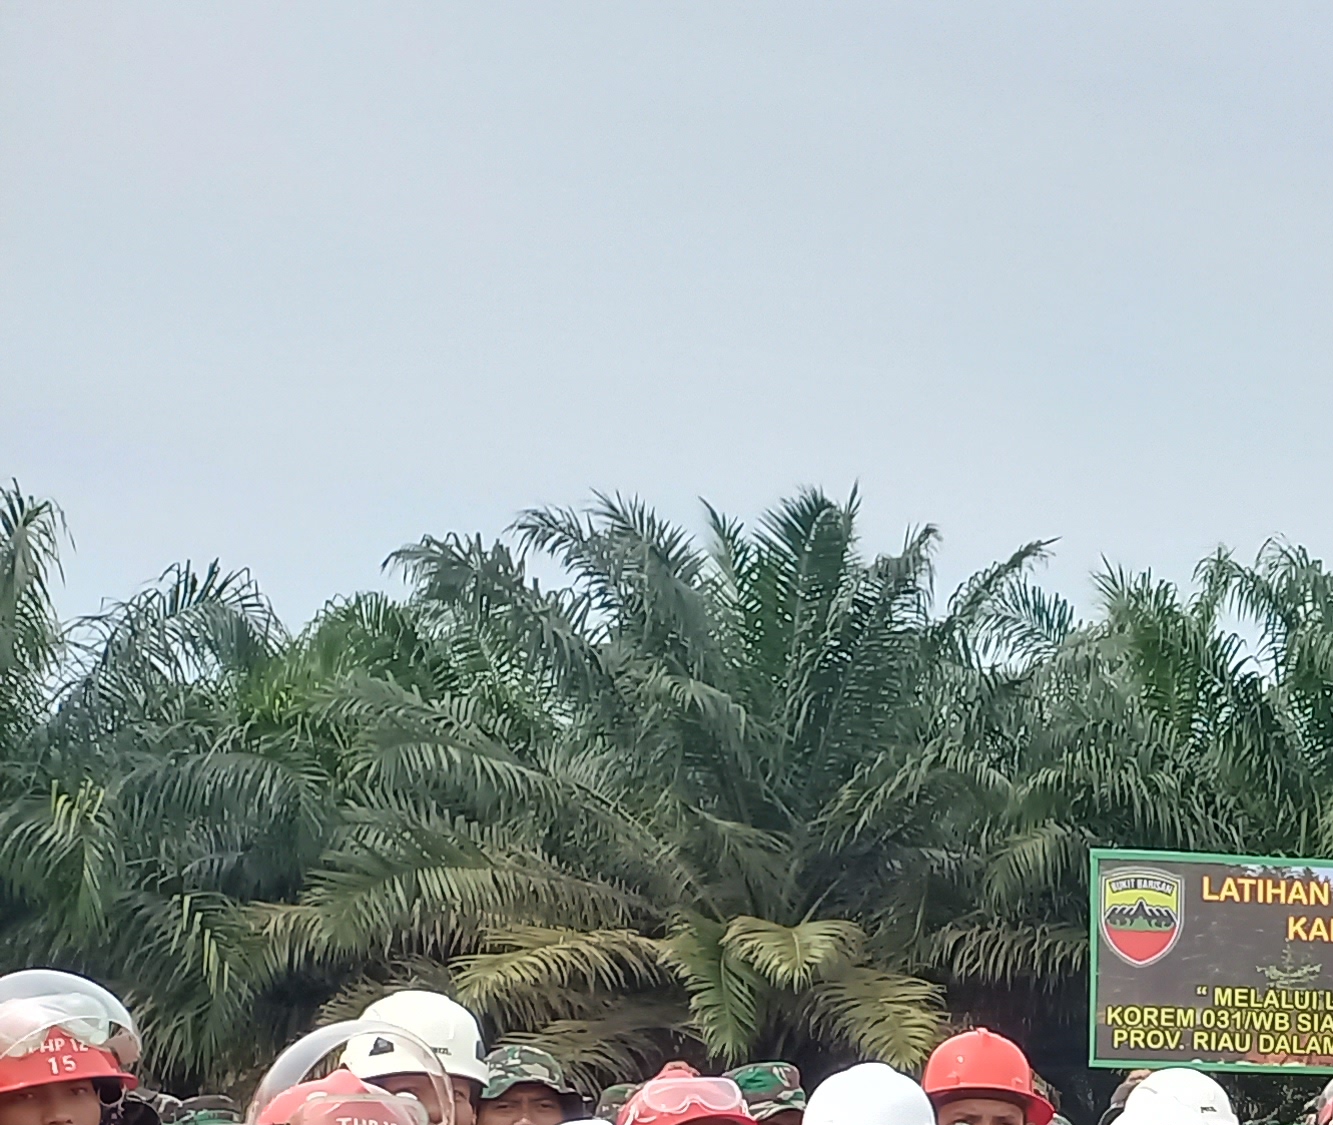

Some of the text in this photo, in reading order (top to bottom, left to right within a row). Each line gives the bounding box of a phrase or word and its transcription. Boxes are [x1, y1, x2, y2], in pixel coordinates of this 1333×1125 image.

[1137, 879, 1174, 895] BARISAN
[1202, 876, 1330, 906] LATIHAN
[1214, 987, 1318, 1011] MELALUI
[1106, 1006, 1194, 1028] KOREM
[1202, 1010, 1290, 1032] 031/WB
[1113, 1029, 1185, 1050] PROV.
[1193, 1032, 1251, 1052] RIAU
[47, 1055, 77, 1075] 15
